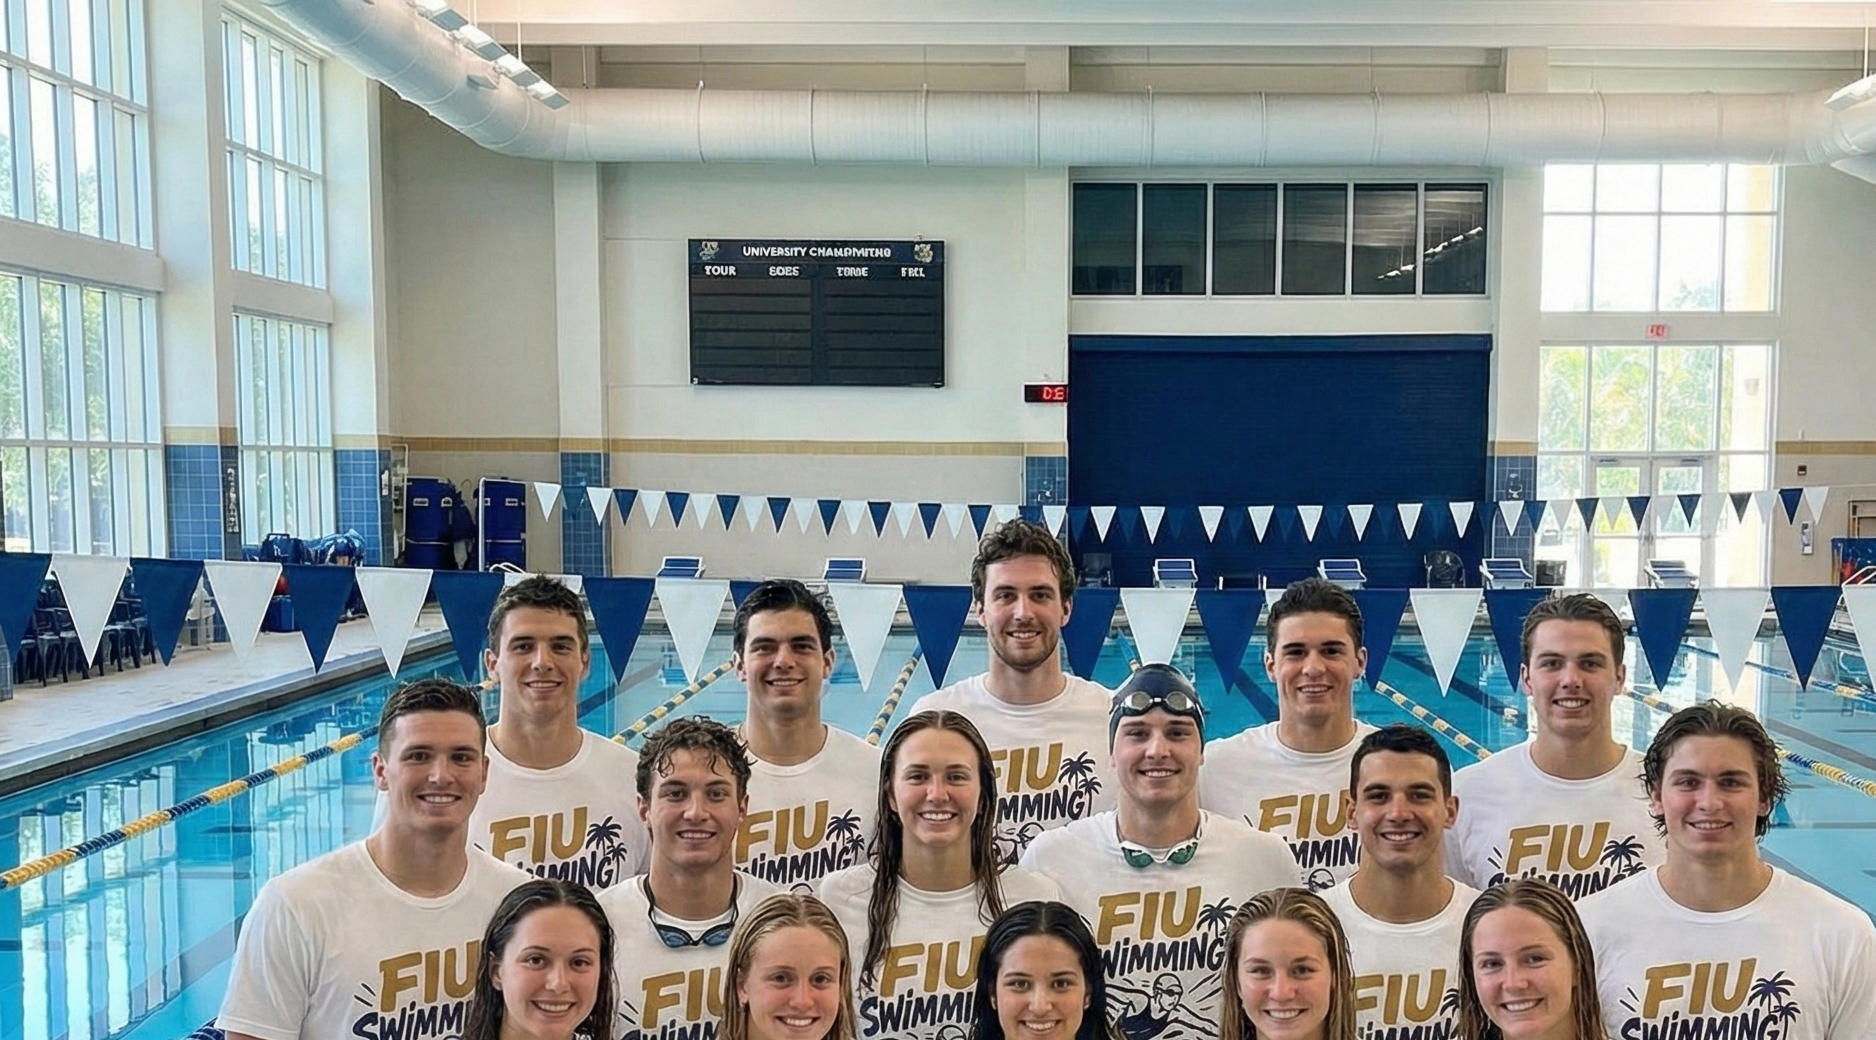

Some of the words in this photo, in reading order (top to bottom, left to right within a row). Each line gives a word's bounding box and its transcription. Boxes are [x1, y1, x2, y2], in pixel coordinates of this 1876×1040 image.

[704, 265, 737, 276] TOUR
[742, 246, 807, 257] UNIVERSITY
[997, 784, 1086, 823] MMING
[1258, 788, 1350, 839] FIU
[489, 806, 588, 865] FIU
[735, 800, 829, 864] FIU
[1282, 832, 1362, 869] MMIN
[1505, 822, 1611, 875] FIU
[1096, 885, 1202, 946] FIU
[379, 939, 481, 1013] FIU
[879, 935, 987, 998] FIU
[1100, 931, 1226, 980] WiMMING
[1642, 957, 1758, 1020] FIU
